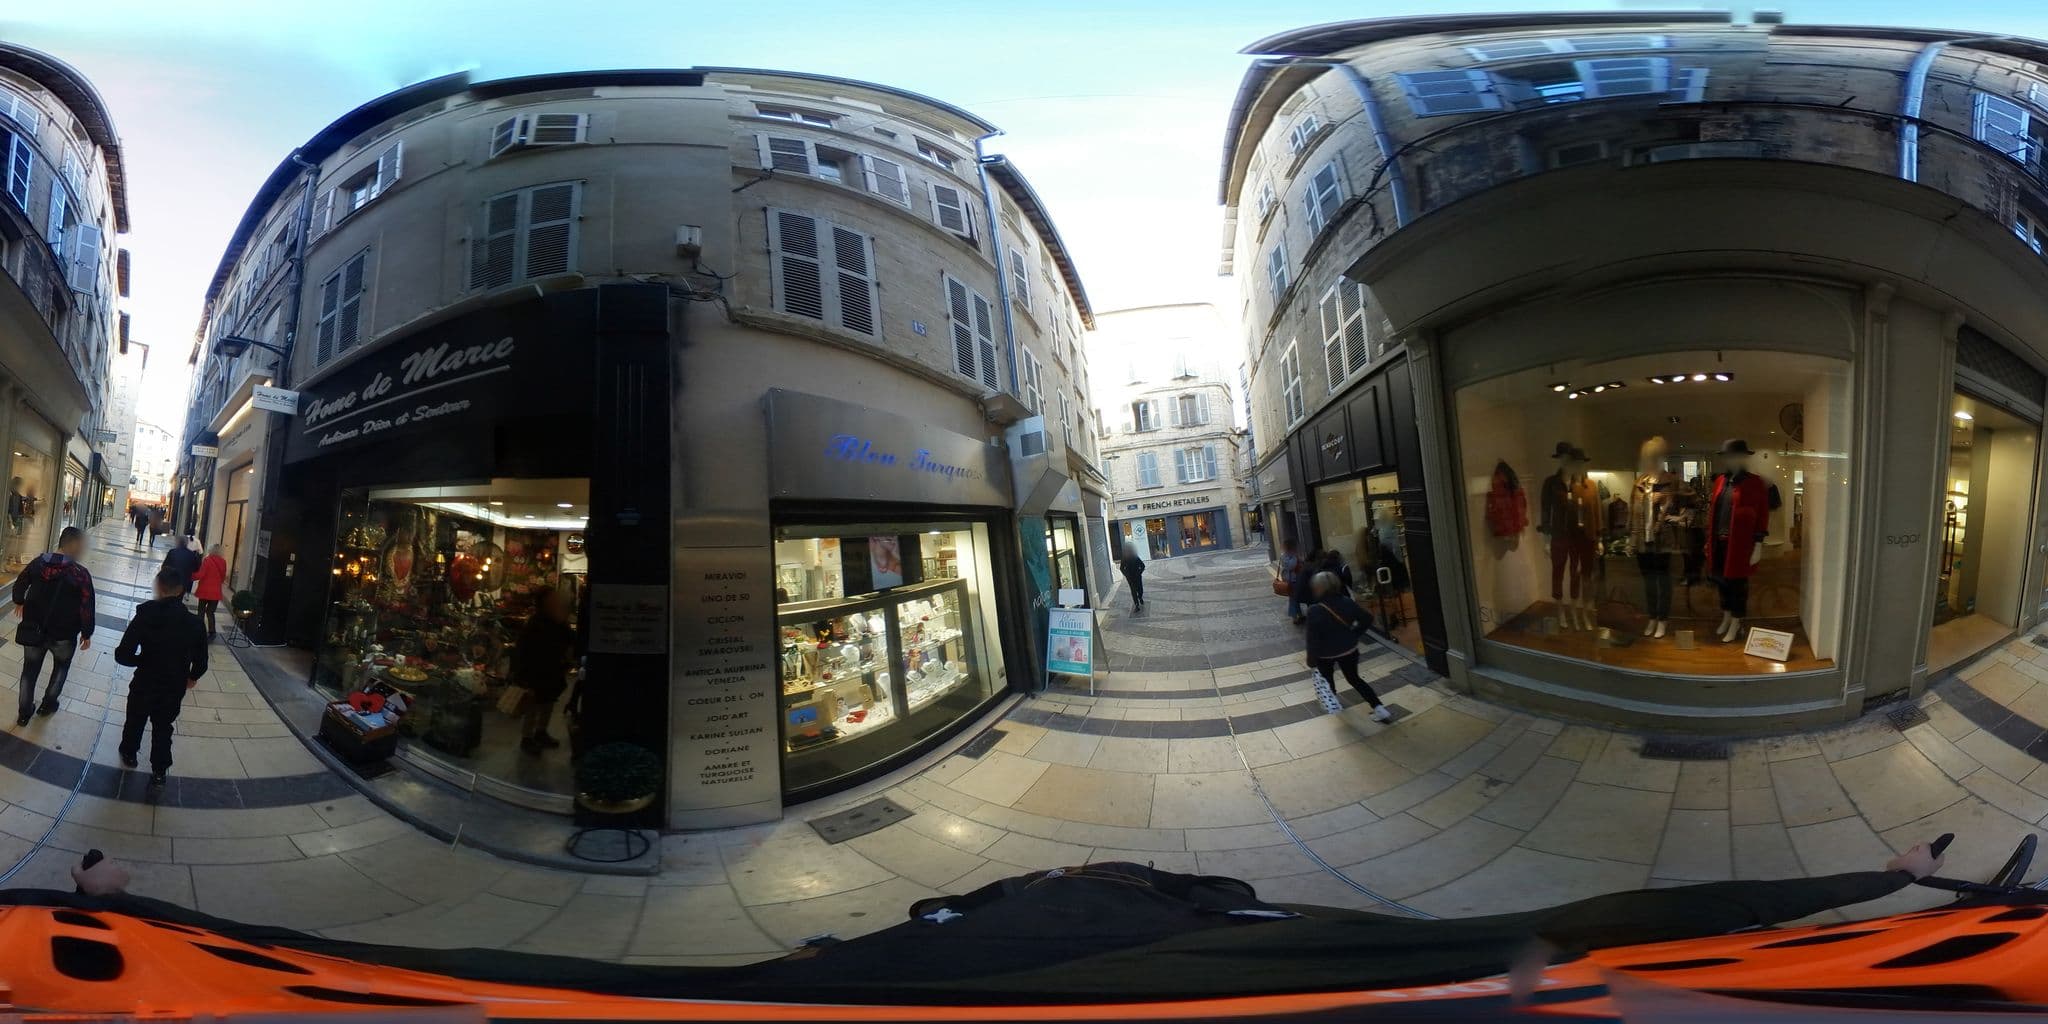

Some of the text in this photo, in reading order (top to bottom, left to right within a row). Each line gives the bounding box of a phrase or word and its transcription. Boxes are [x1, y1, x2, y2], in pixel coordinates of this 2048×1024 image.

[304, 337, 515, 426] Home de Marie
[824, 433, 897, 468] Bleu
[1142, 500, 1172, 511] FRENCH
[1173, 496, 1210, 507] RETAILERS
[1886, 533, 1922, 548] sugar
[726, 594, 737, 602] DE
[707, 615, 744, 624] CICLON
[708, 637, 744, 645] CRISTAL
[685, 663, 767, 676] ANTICA MURRINA
[707, 676, 746, 686] VENEZIA
[688, 697, 721, 706] COEUR
[690, 727, 763, 741] KARINE SULTAN
[705, 745, 750, 755] DORIANE
[704, 763, 738, 771] AMBRE
[700, 768, 755, 778] TURQUOISE
[701, 775, 754, 785] NATURELLE
